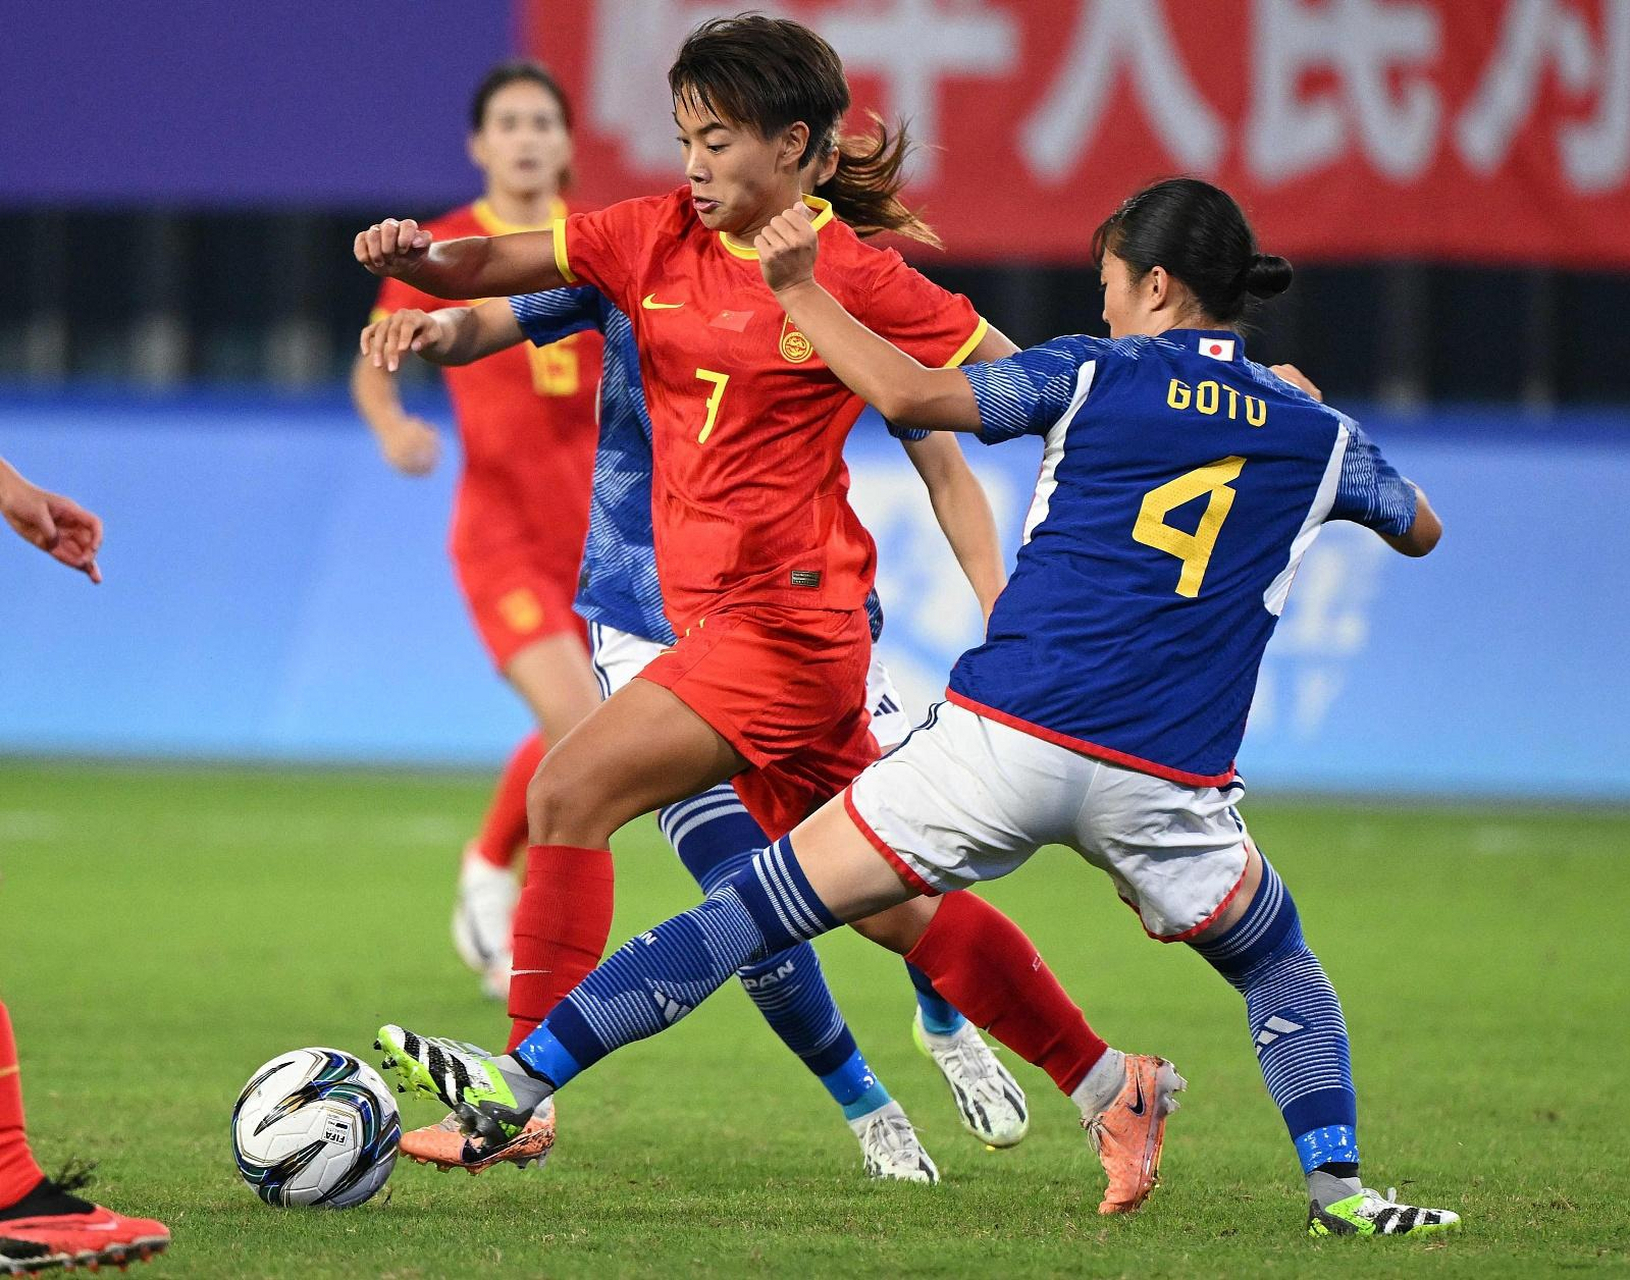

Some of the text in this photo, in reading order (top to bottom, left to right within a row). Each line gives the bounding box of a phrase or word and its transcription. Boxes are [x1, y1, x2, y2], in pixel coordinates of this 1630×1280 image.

[695, 367, 730, 444] 7
[1132, 455, 1247, 598] 4
[325, 1131, 345, 1143] FIFA
